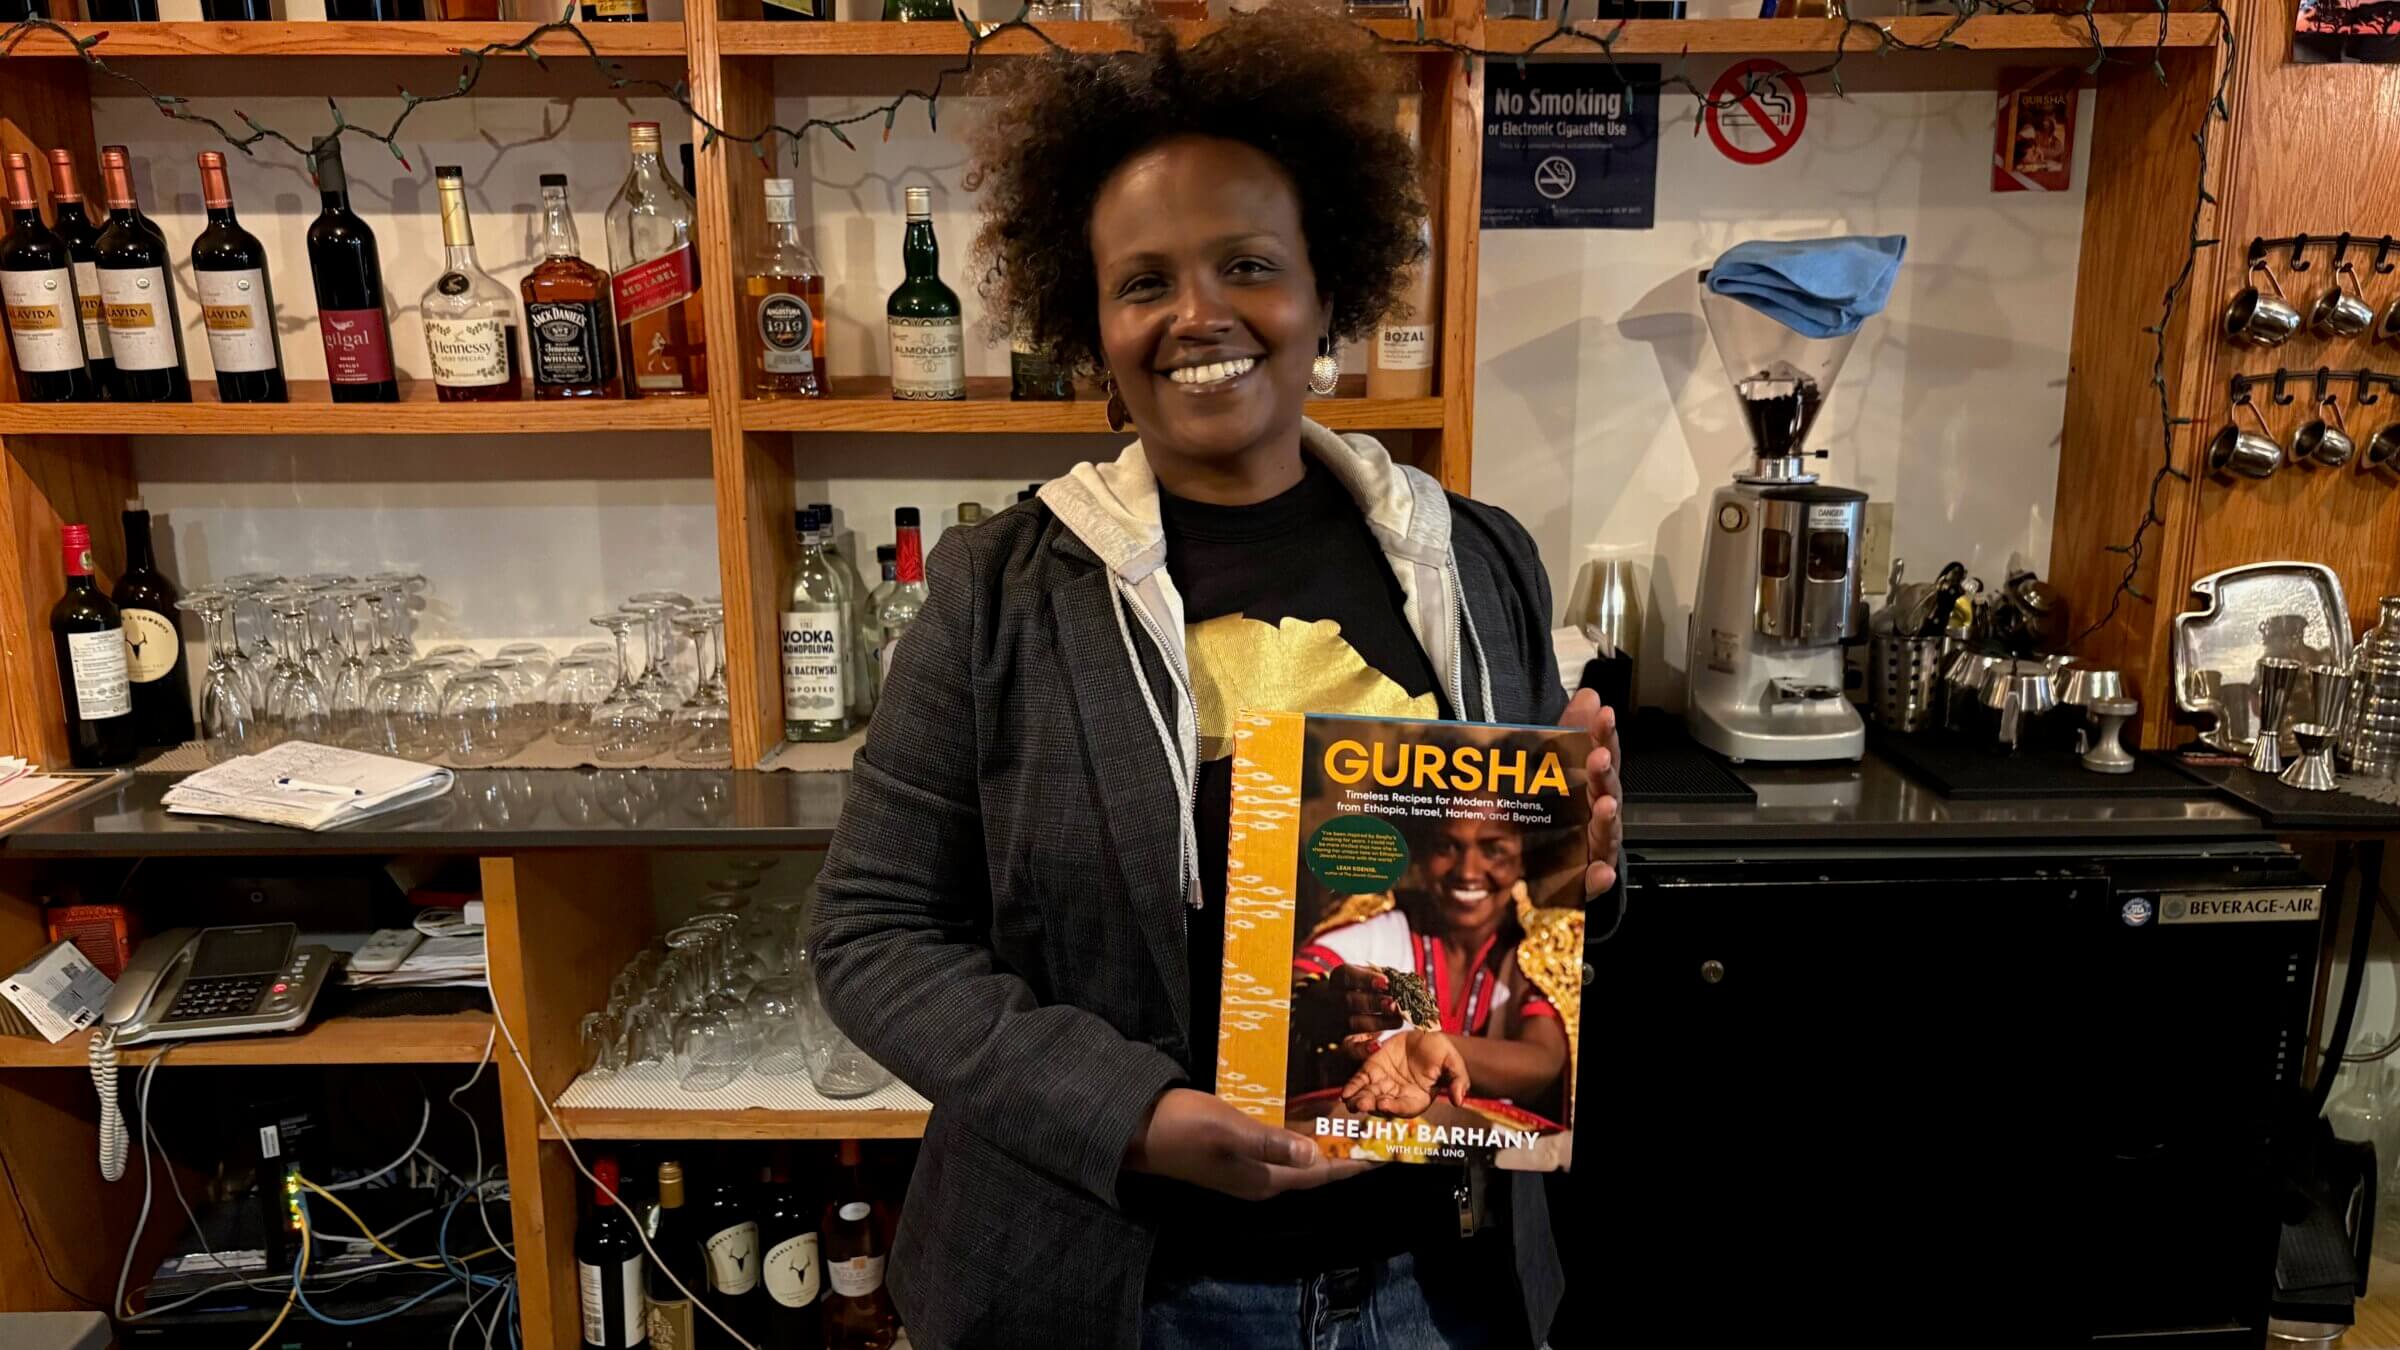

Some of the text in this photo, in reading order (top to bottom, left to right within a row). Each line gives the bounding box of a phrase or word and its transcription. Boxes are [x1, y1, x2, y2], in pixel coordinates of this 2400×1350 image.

[1495, 88, 1621, 119] No Smoking
[1488, 121, 1627, 138] or Electronic Cigarette Use
[621, 270, 676, 297] RED LABEL
[532, 307, 587, 328] JACK DANIEL'S
[767, 320, 803, 332] 1919
[325, 331, 369, 351] gilgal
[1384, 331, 1425, 342] BOZAL
[434, 340, 492, 355] Hennessy
[544, 355, 583, 363] WHISKEY
[1818, 508, 1844, 517] DANGER
[782, 630, 834, 643] VODKA
[794, 663, 838, 676] BACZEWSKI
[1324, 739, 1570, 796] GURSHA
[1345, 789, 1544, 812] Timeless Recipes for Modern Kitchens,
[1337, 802, 1551, 825] from Ethiopia, Israel, Harlem, and Beyond
[2190, 898, 2314, 915] BEVERAGE-AIR
[1315, 1116, 1540, 1150] BEEJHY BARHANY
[1386, 1144, 1465, 1158] WITH ELISA UNG
